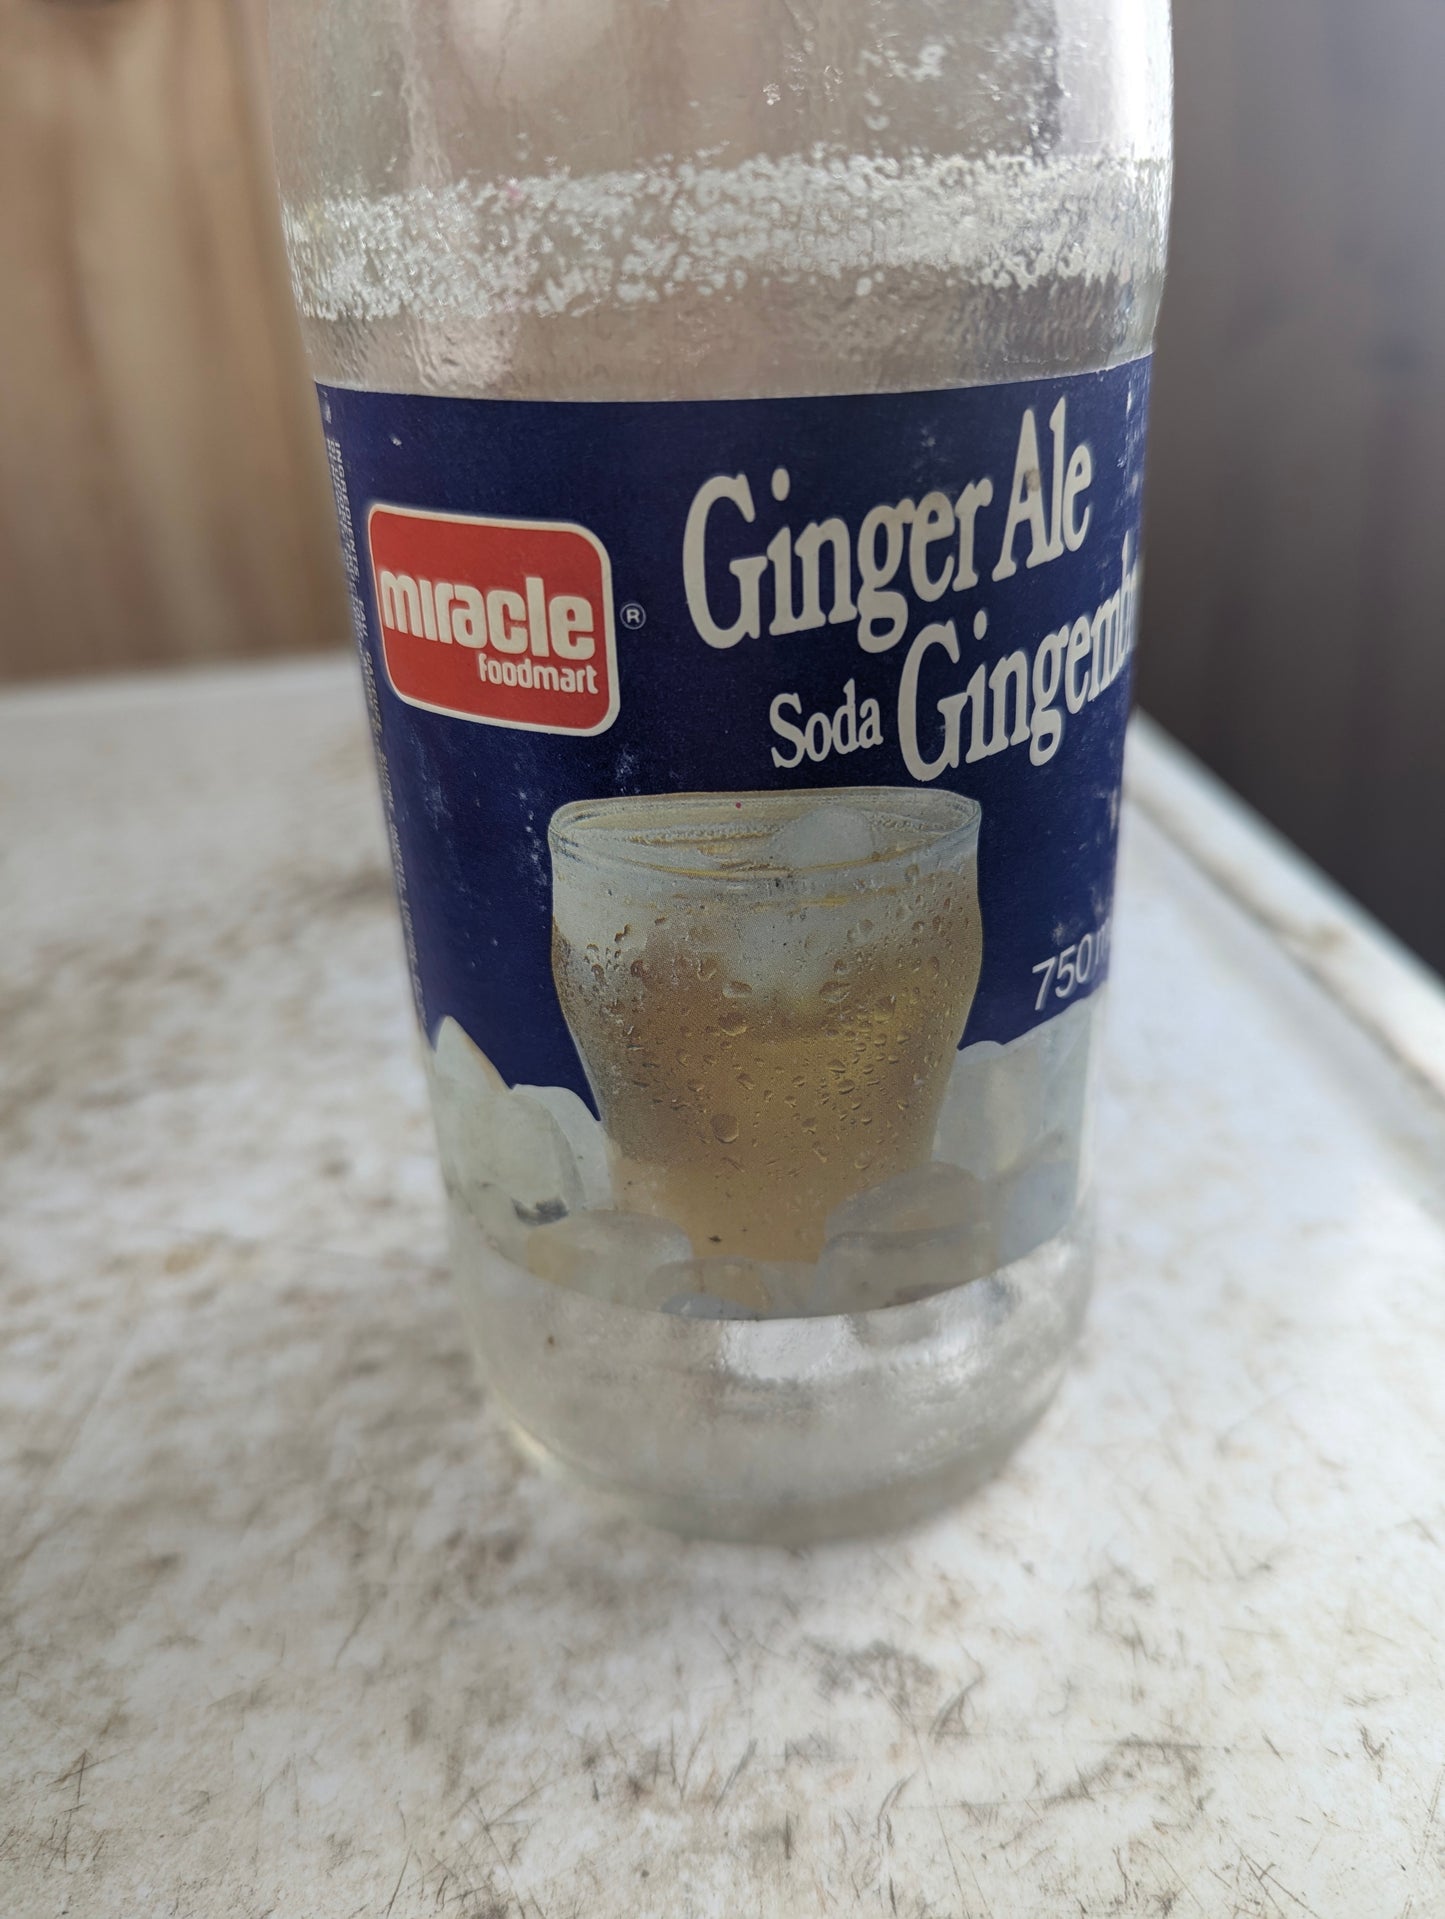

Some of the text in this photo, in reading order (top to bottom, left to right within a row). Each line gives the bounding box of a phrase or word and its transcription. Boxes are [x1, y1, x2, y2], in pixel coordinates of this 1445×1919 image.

[682, 396, 1092, 653] Ginger Ale
[379, 570, 596, 660] miracle
[769, 528, 1138, 781] Soda Gingemb
[478, 652, 599, 695] foodmart
[1032, 932, 1091, 1011] 750
